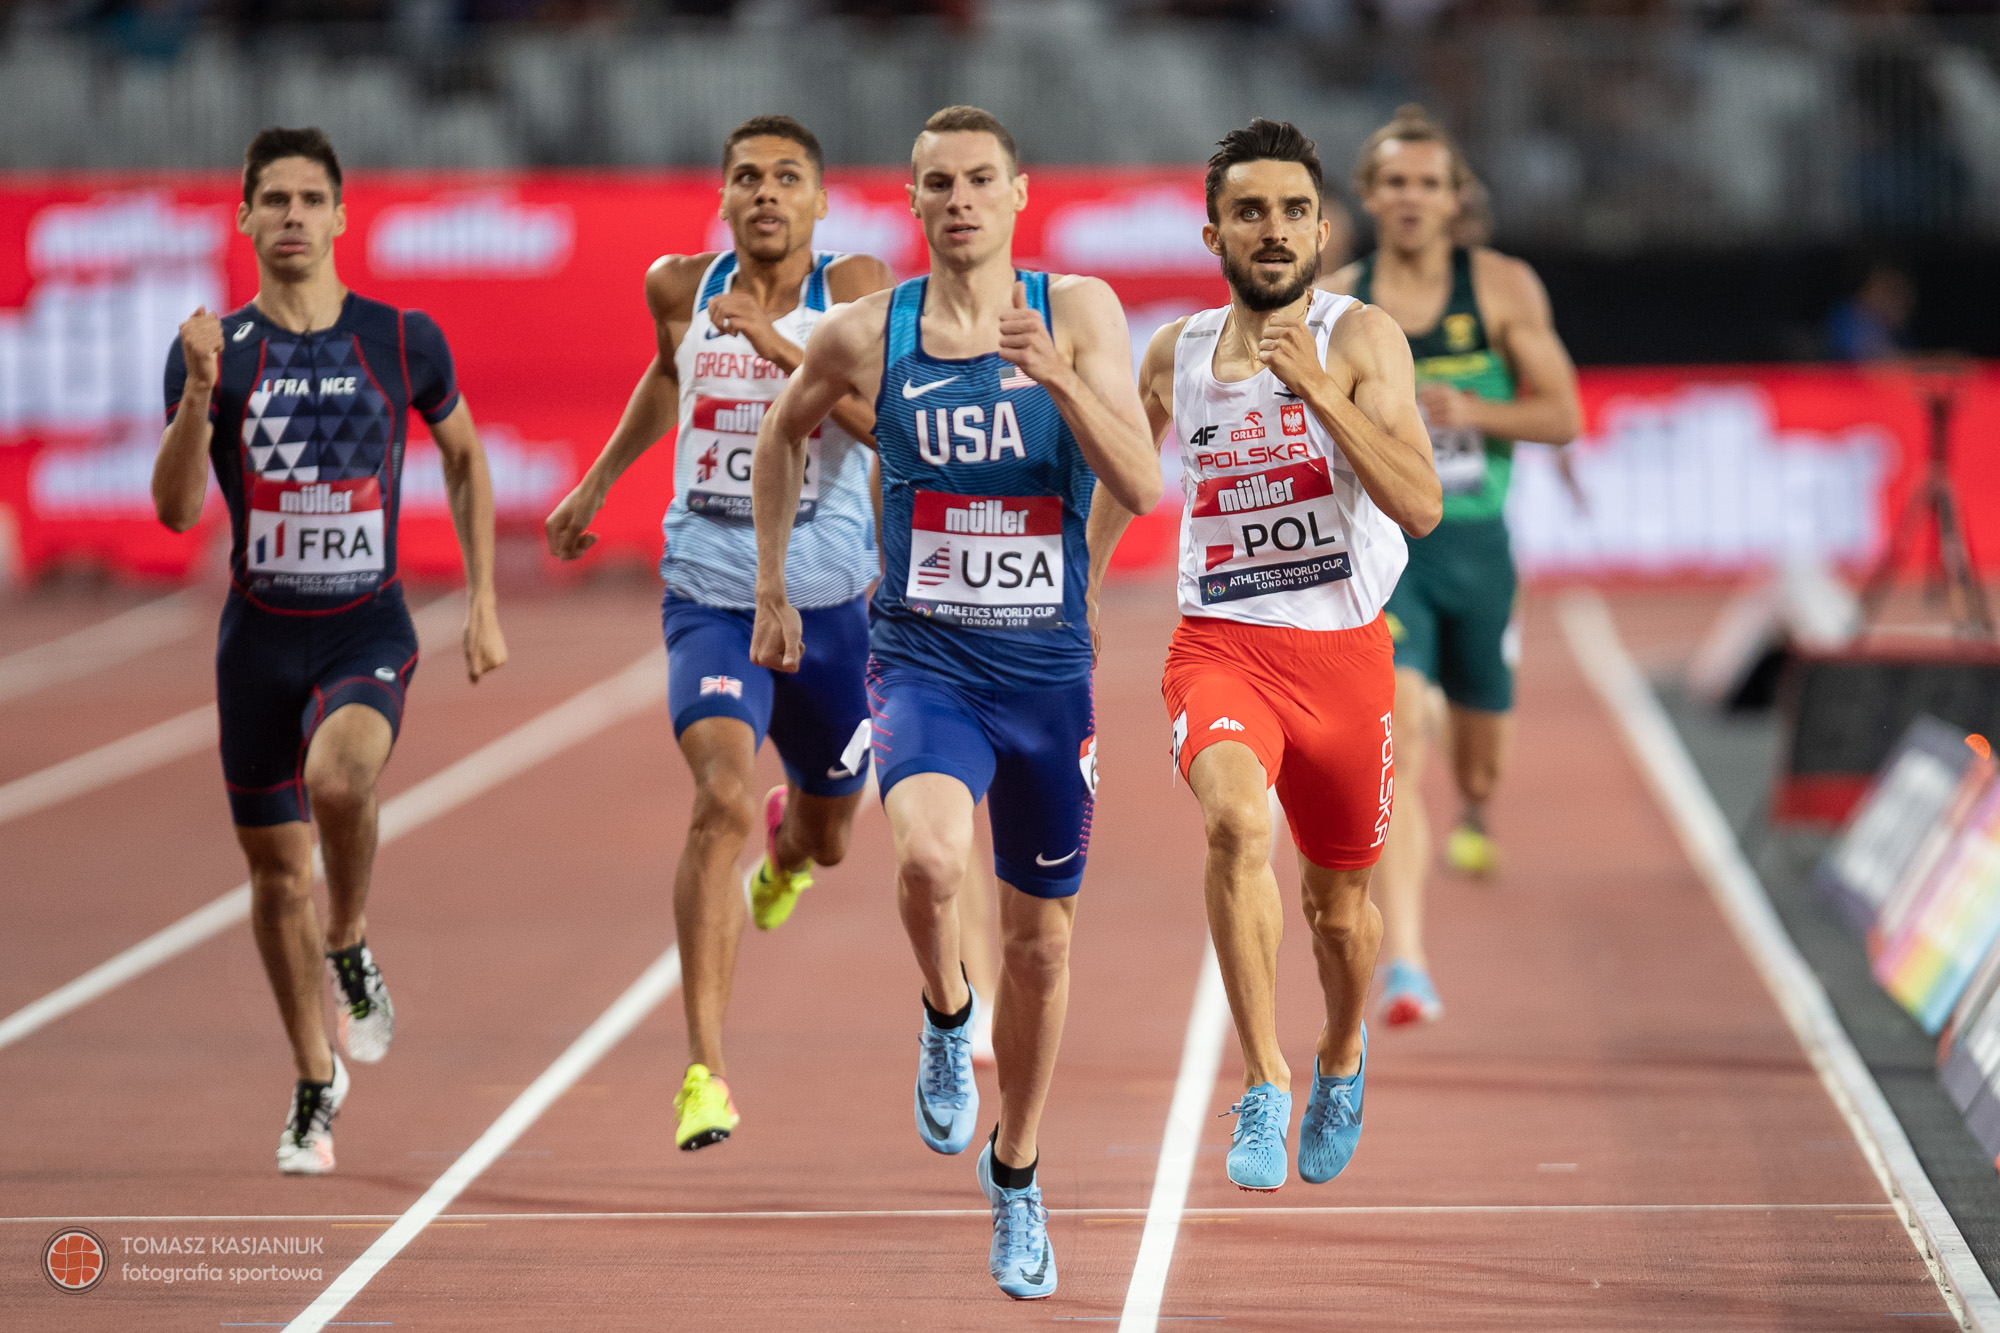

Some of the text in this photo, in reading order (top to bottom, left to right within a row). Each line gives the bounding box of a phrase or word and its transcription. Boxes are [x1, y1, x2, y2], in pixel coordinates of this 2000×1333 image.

[694, 352, 753, 379] GREAT
[714, 402, 765, 433] müll
[915, 401, 1027, 466] USA
[1190, 425, 1219, 446] 4F
[1232, 428, 1265, 440] ORLEN
[1197, 443, 1310, 471] POLSKA
[280, 483, 353, 513] müller
[1217, 474, 1294, 513] müller
[945, 500, 1029, 534] müller
[299, 525, 373, 560] FRA
[1241, 511, 1336, 558] POL
[962, 550, 1055, 589] USA
[1229, 558, 1344, 588] ATHLETICS WORLD CUP
[1256, 573, 1320, 590] LONDON 2018
[935, 604, 1056, 618] ATHLETICS WORLD CUP
[962, 617, 1029, 626] LONDON 2018
[1370, 711, 1394, 848] POLSKA
